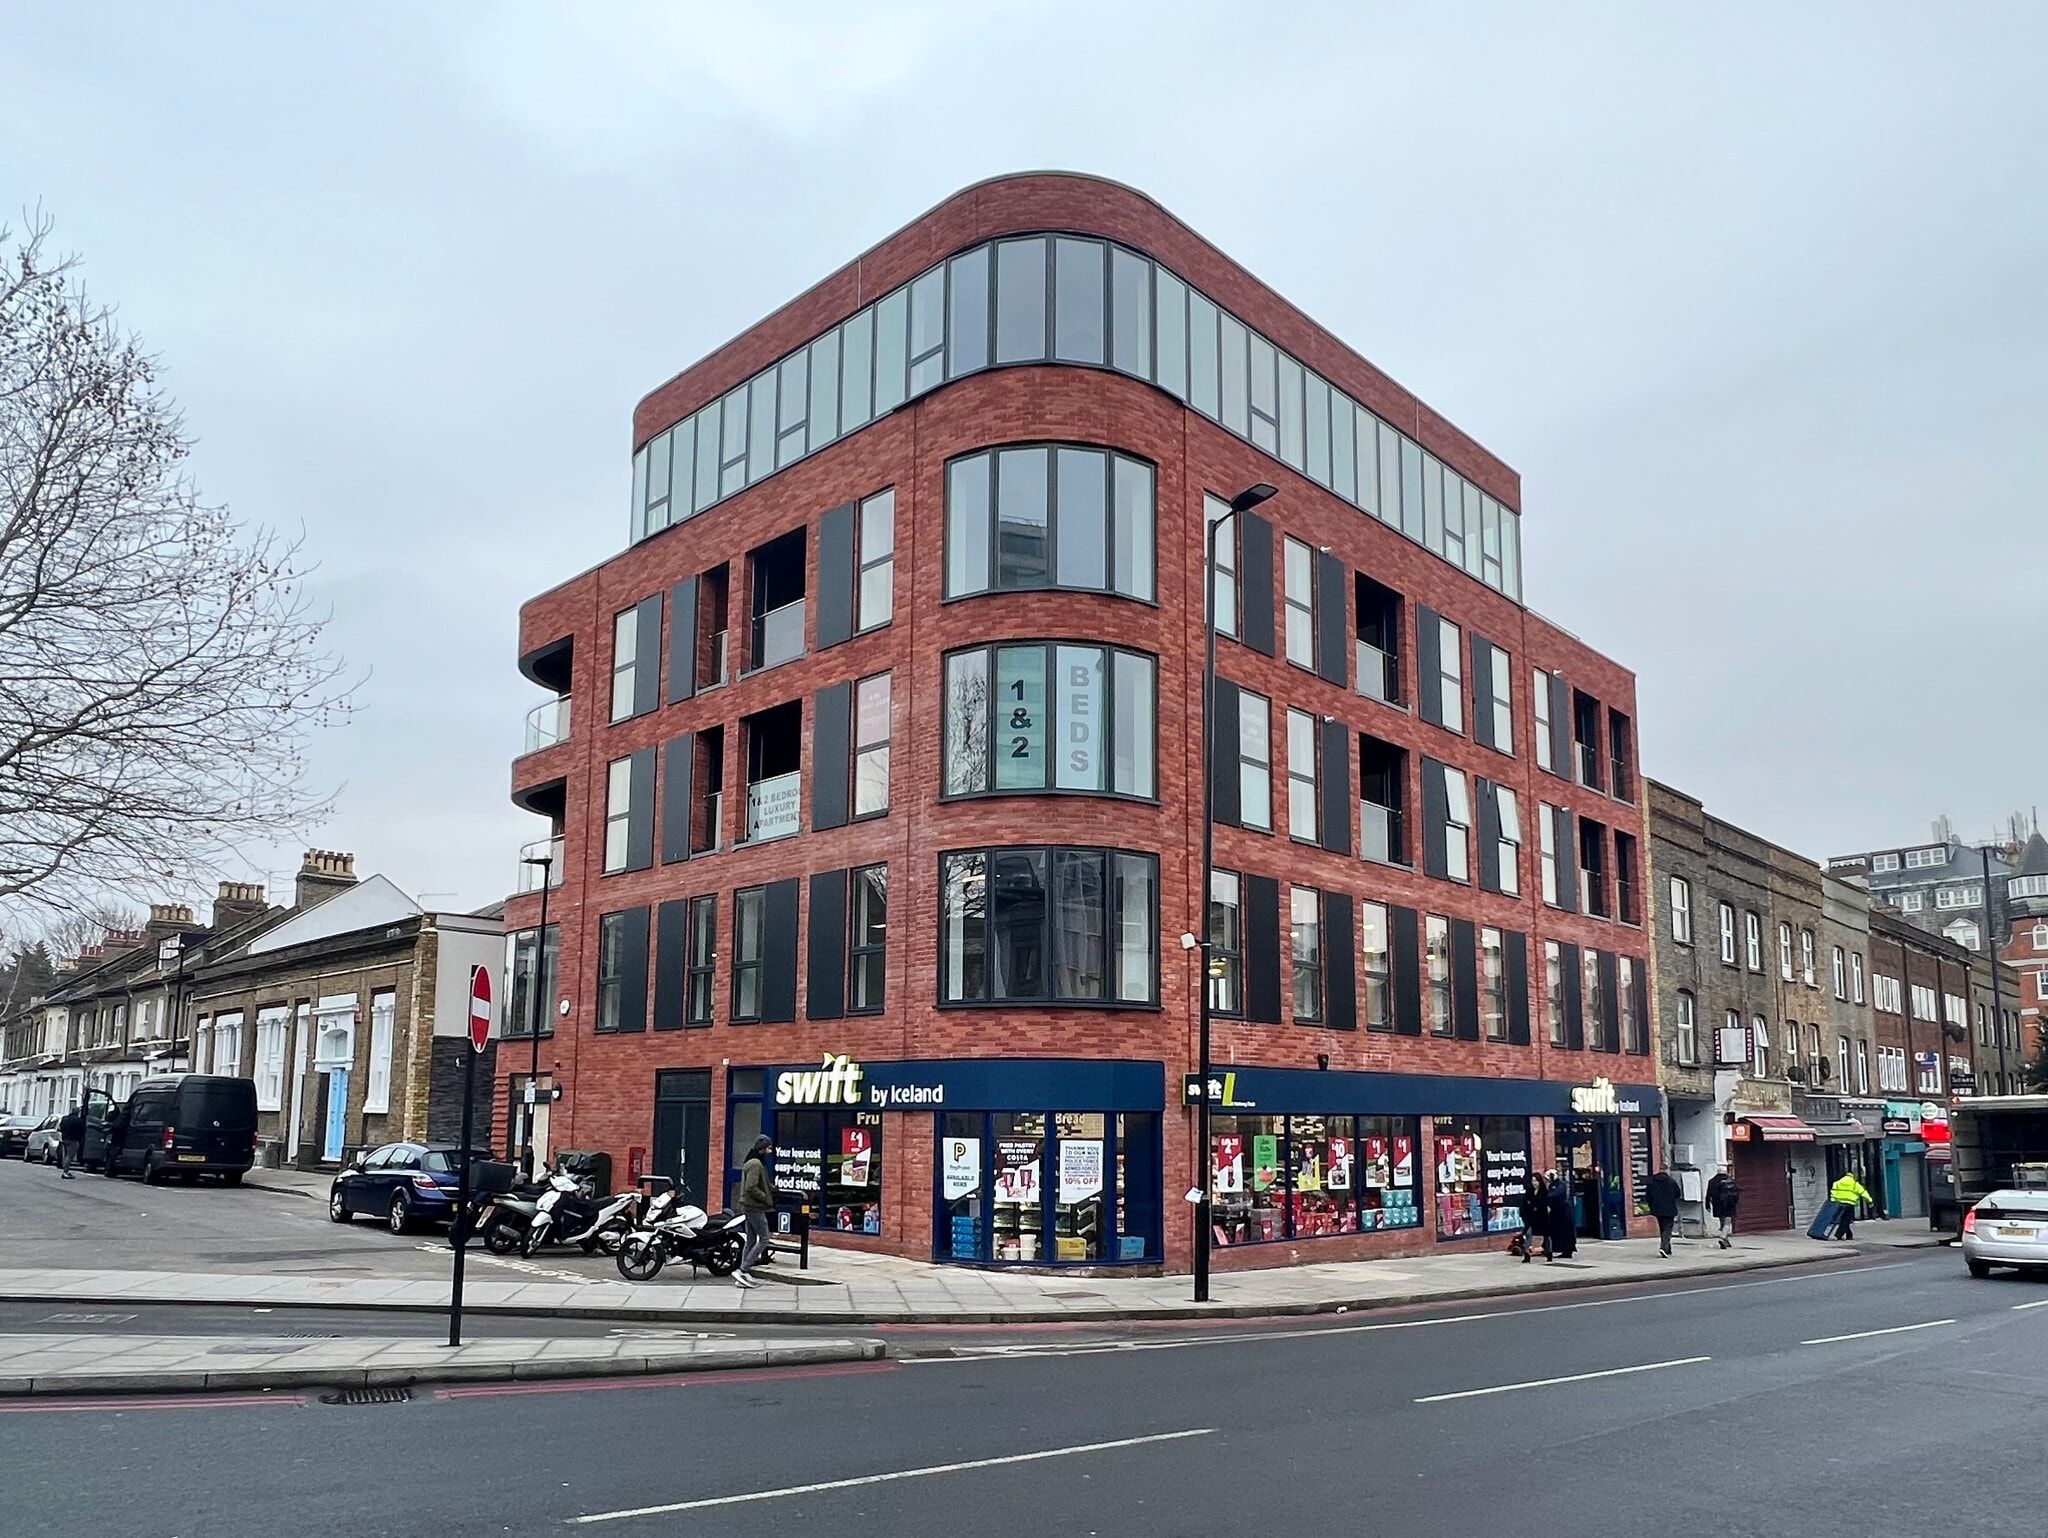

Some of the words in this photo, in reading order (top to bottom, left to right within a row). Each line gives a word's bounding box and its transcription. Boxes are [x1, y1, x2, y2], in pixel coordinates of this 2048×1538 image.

[1070, 665, 1090, 772] BEDS
[764, 800, 796, 816] LUXURY
[776, 1052, 864, 1105] swift
[871, 1085, 888, 1107] by
[890, 1084, 944, 1104] Iceland
[1571, 1076, 1615, 1113] swift
[1055, 1112, 1085, 1125] Bread
[850, 1131, 864, 1149] £1
[775, 1147, 791, 1158] Your
[791, 1148, 805, 1158] low
[1486, 1150, 1500, 1161] Your
[775, 1162, 821, 1175] easy-to-shop
[775, 1176, 795, 1189] food
[795, 1177, 821, 1191] store.
[1487, 1182, 1505, 1197] food
[1505, 1182, 1526, 1195] store.
